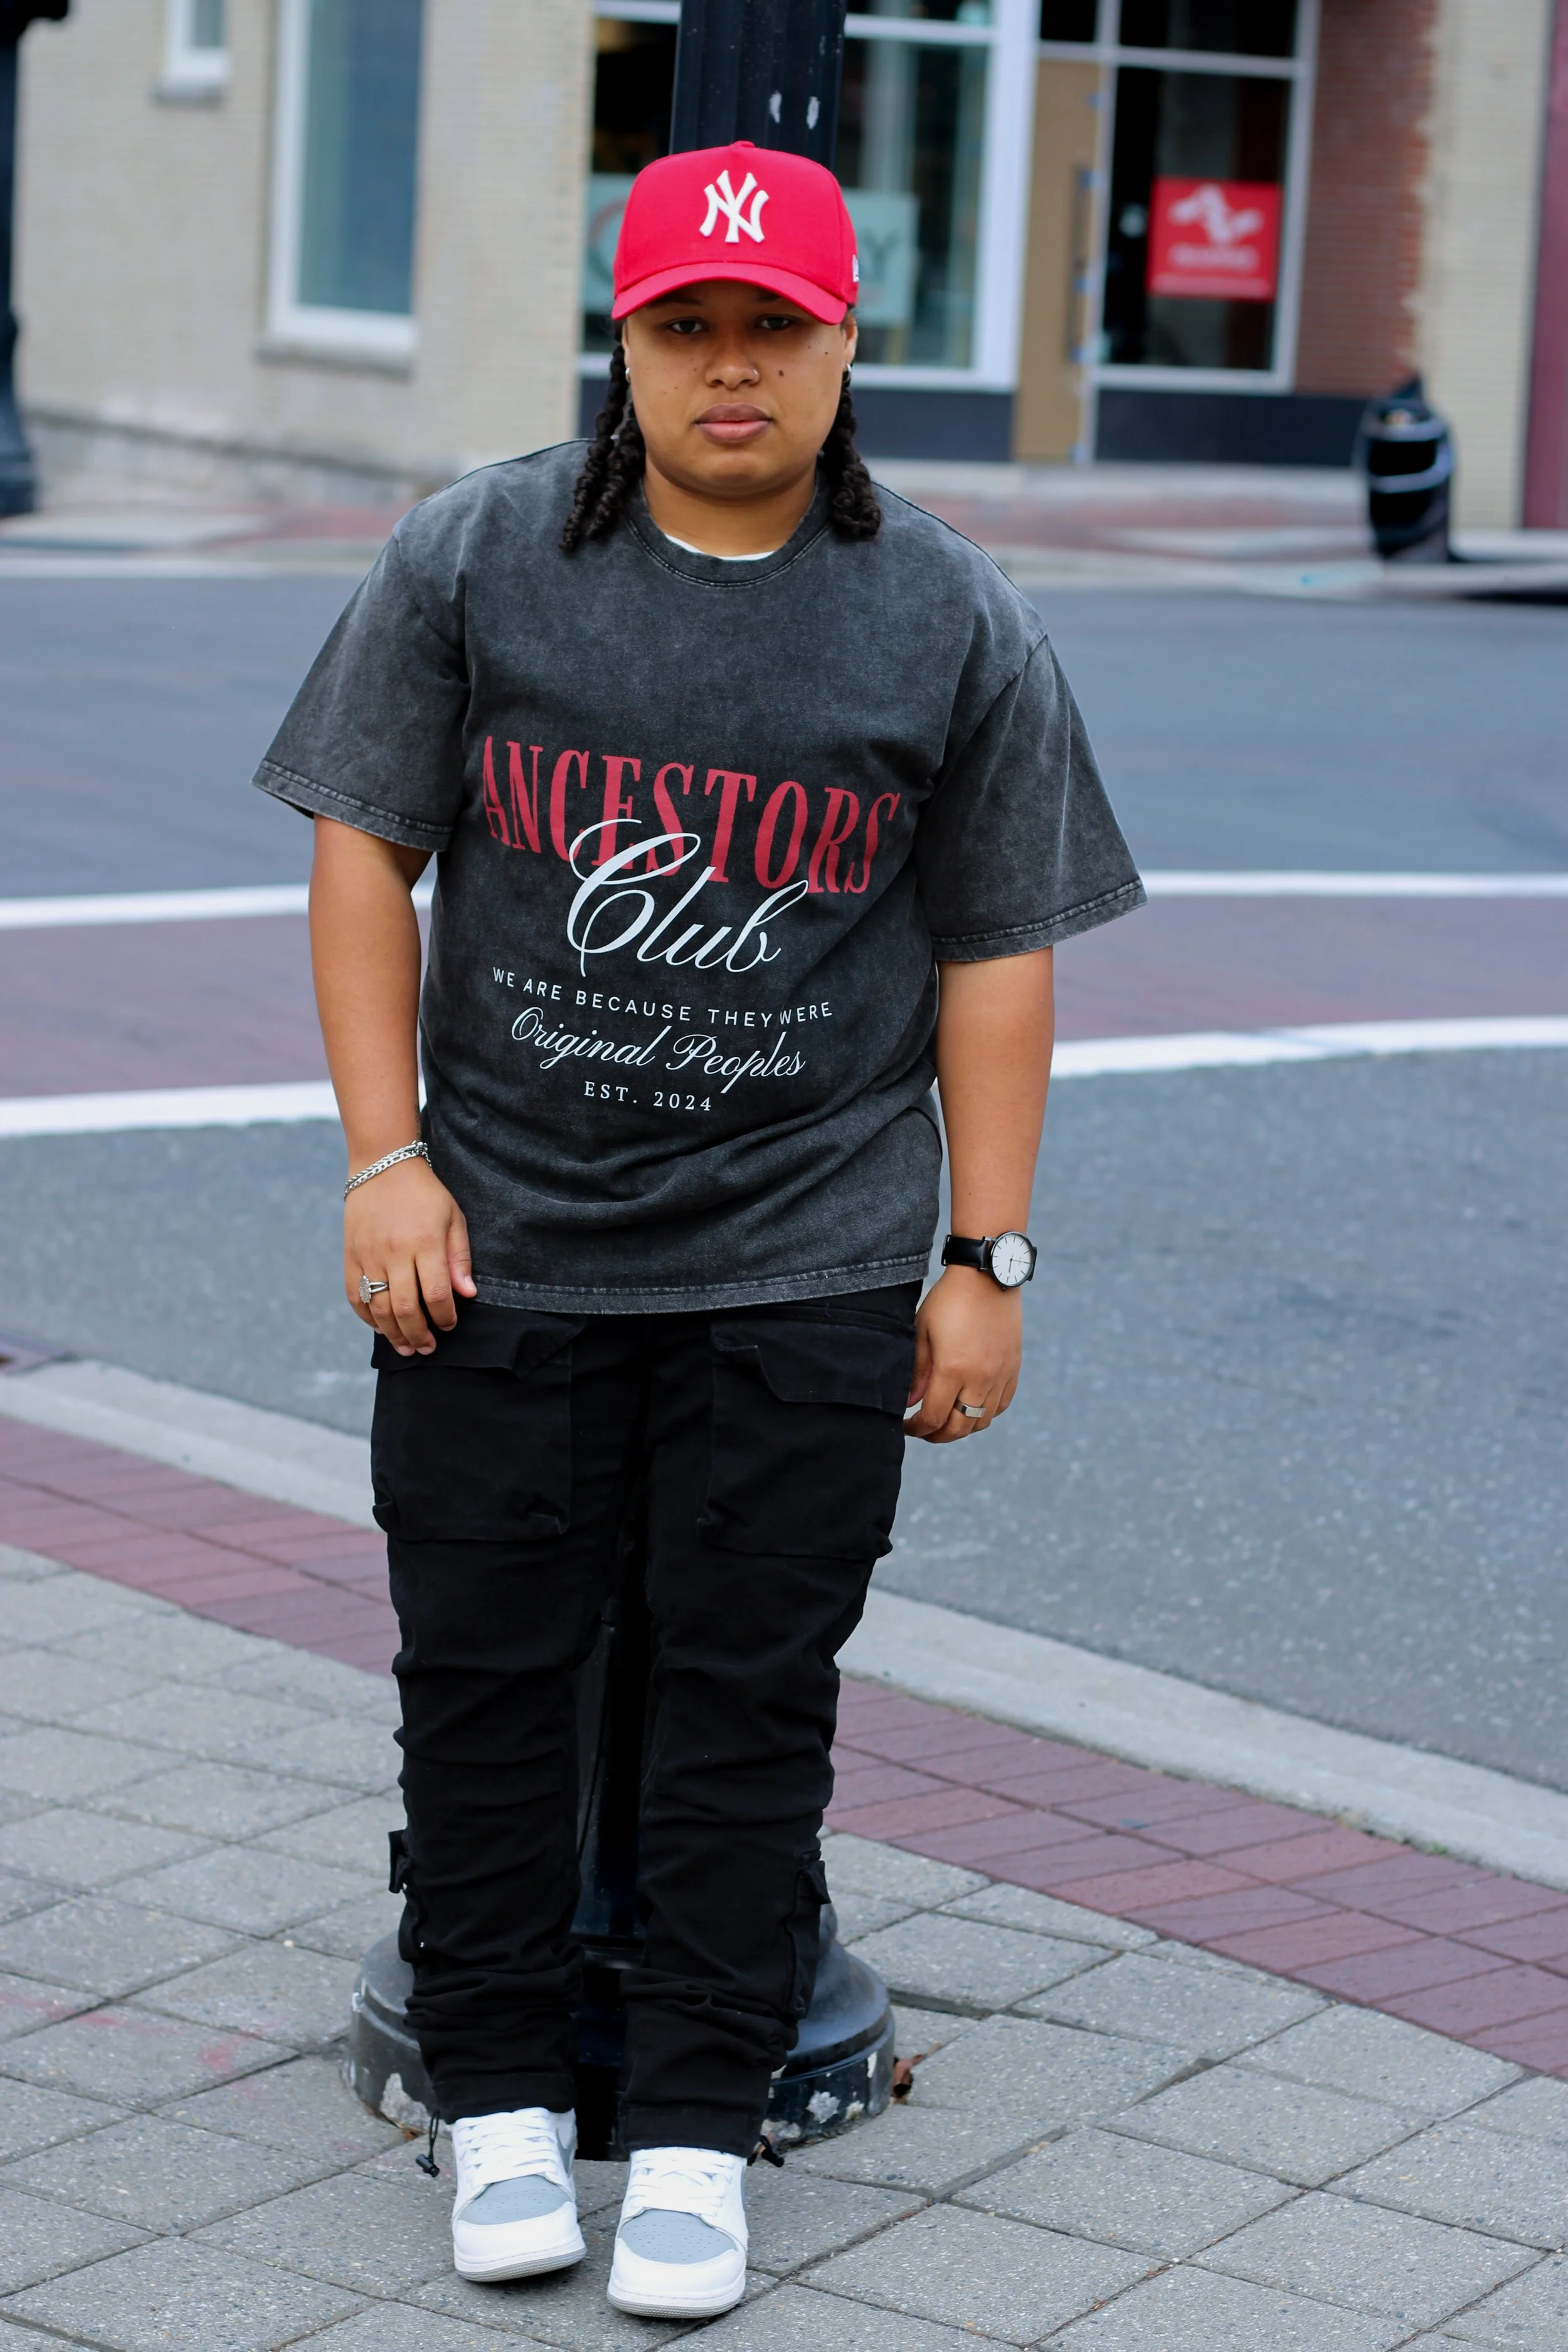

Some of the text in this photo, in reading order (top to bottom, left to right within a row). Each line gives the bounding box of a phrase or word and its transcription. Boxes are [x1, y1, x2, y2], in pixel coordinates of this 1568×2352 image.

[482, 735, 901, 894] ANCESTORS
[566, 818, 810, 977] Club
[493, 967, 516, 988] WE
[522, 978, 562, 1000] ARE
[576, 990, 691, 1021] BECAUSE
[511, 1007, 807, 1094] Original Peoples
[583, 1081, 712, 1111] EST. 2024
